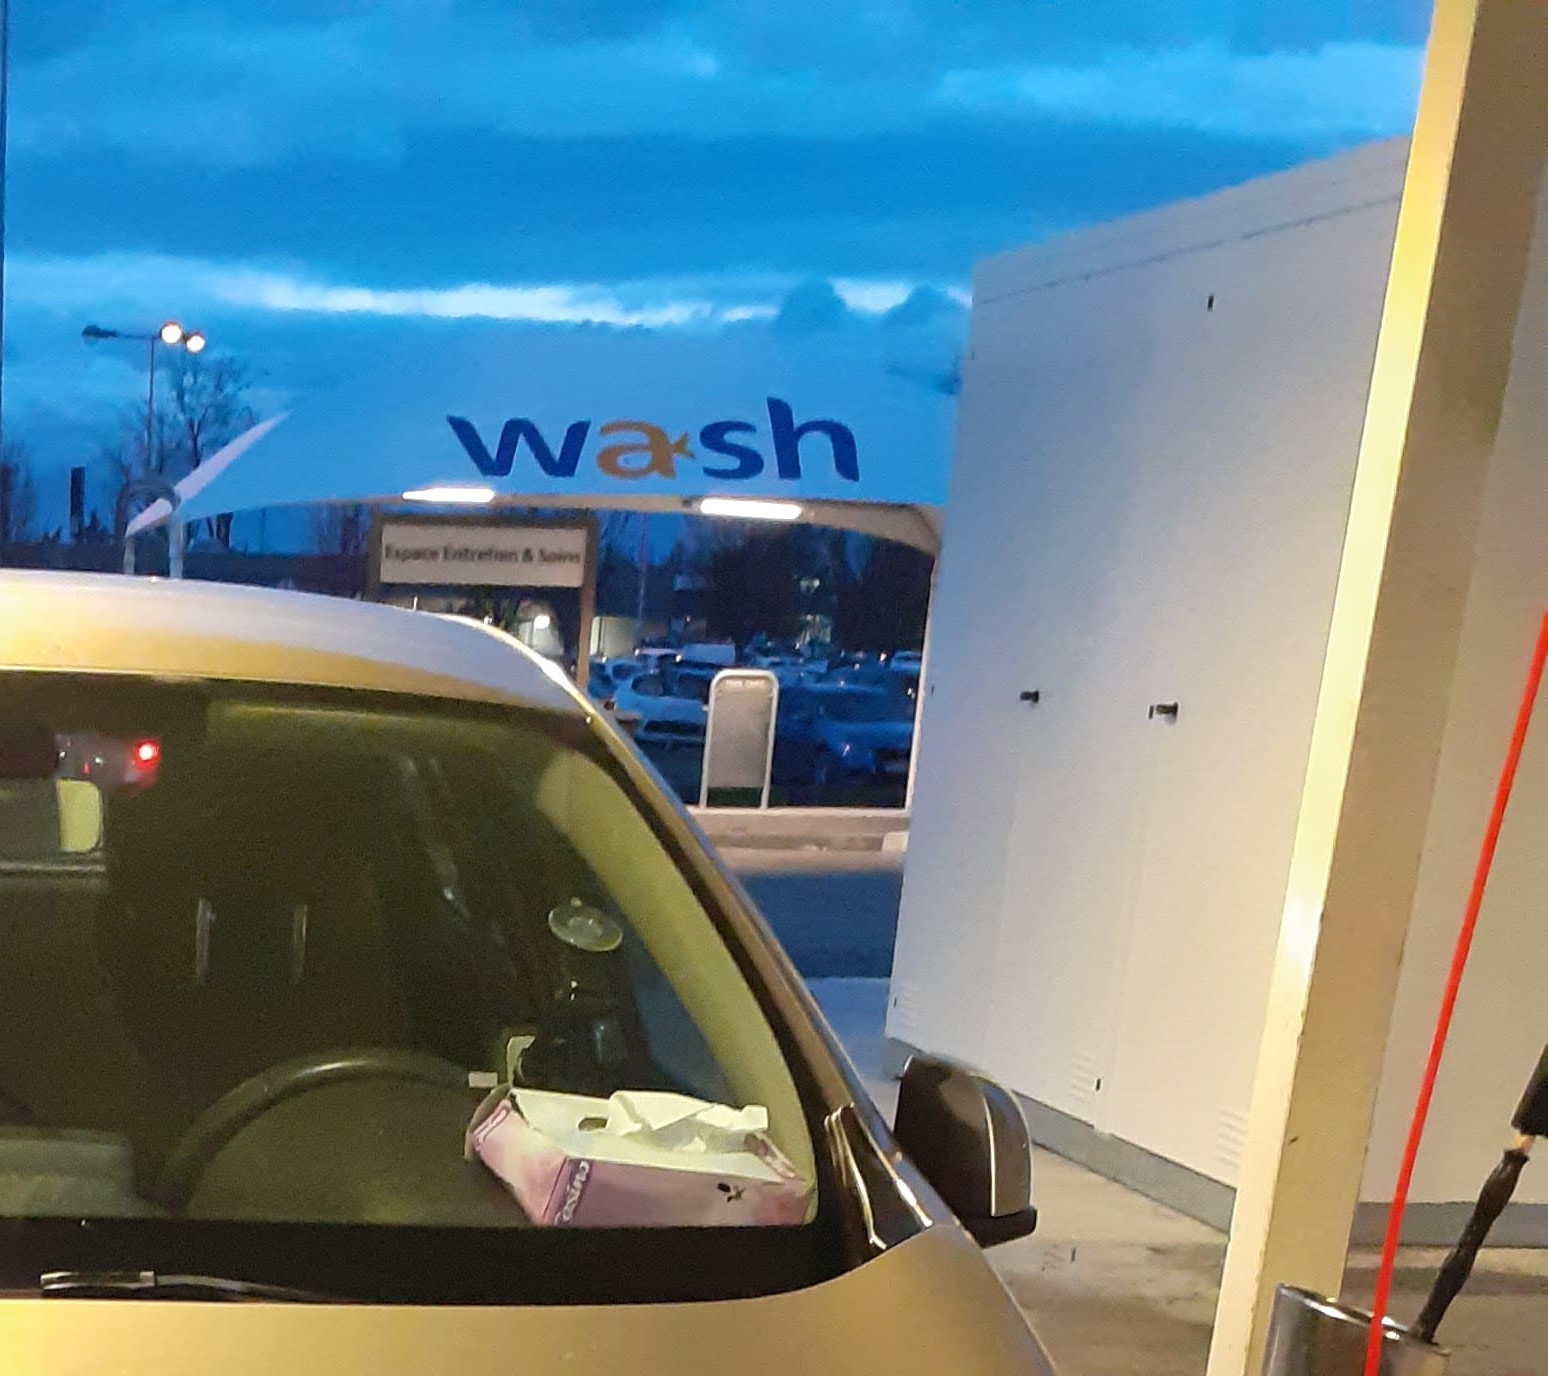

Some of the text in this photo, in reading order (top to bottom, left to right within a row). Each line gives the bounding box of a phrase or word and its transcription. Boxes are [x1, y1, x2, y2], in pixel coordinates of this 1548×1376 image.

[445, 396, 860, 483] wash
[384, 544, 439, 563] Espace
[521, 548, 534, 562] &
